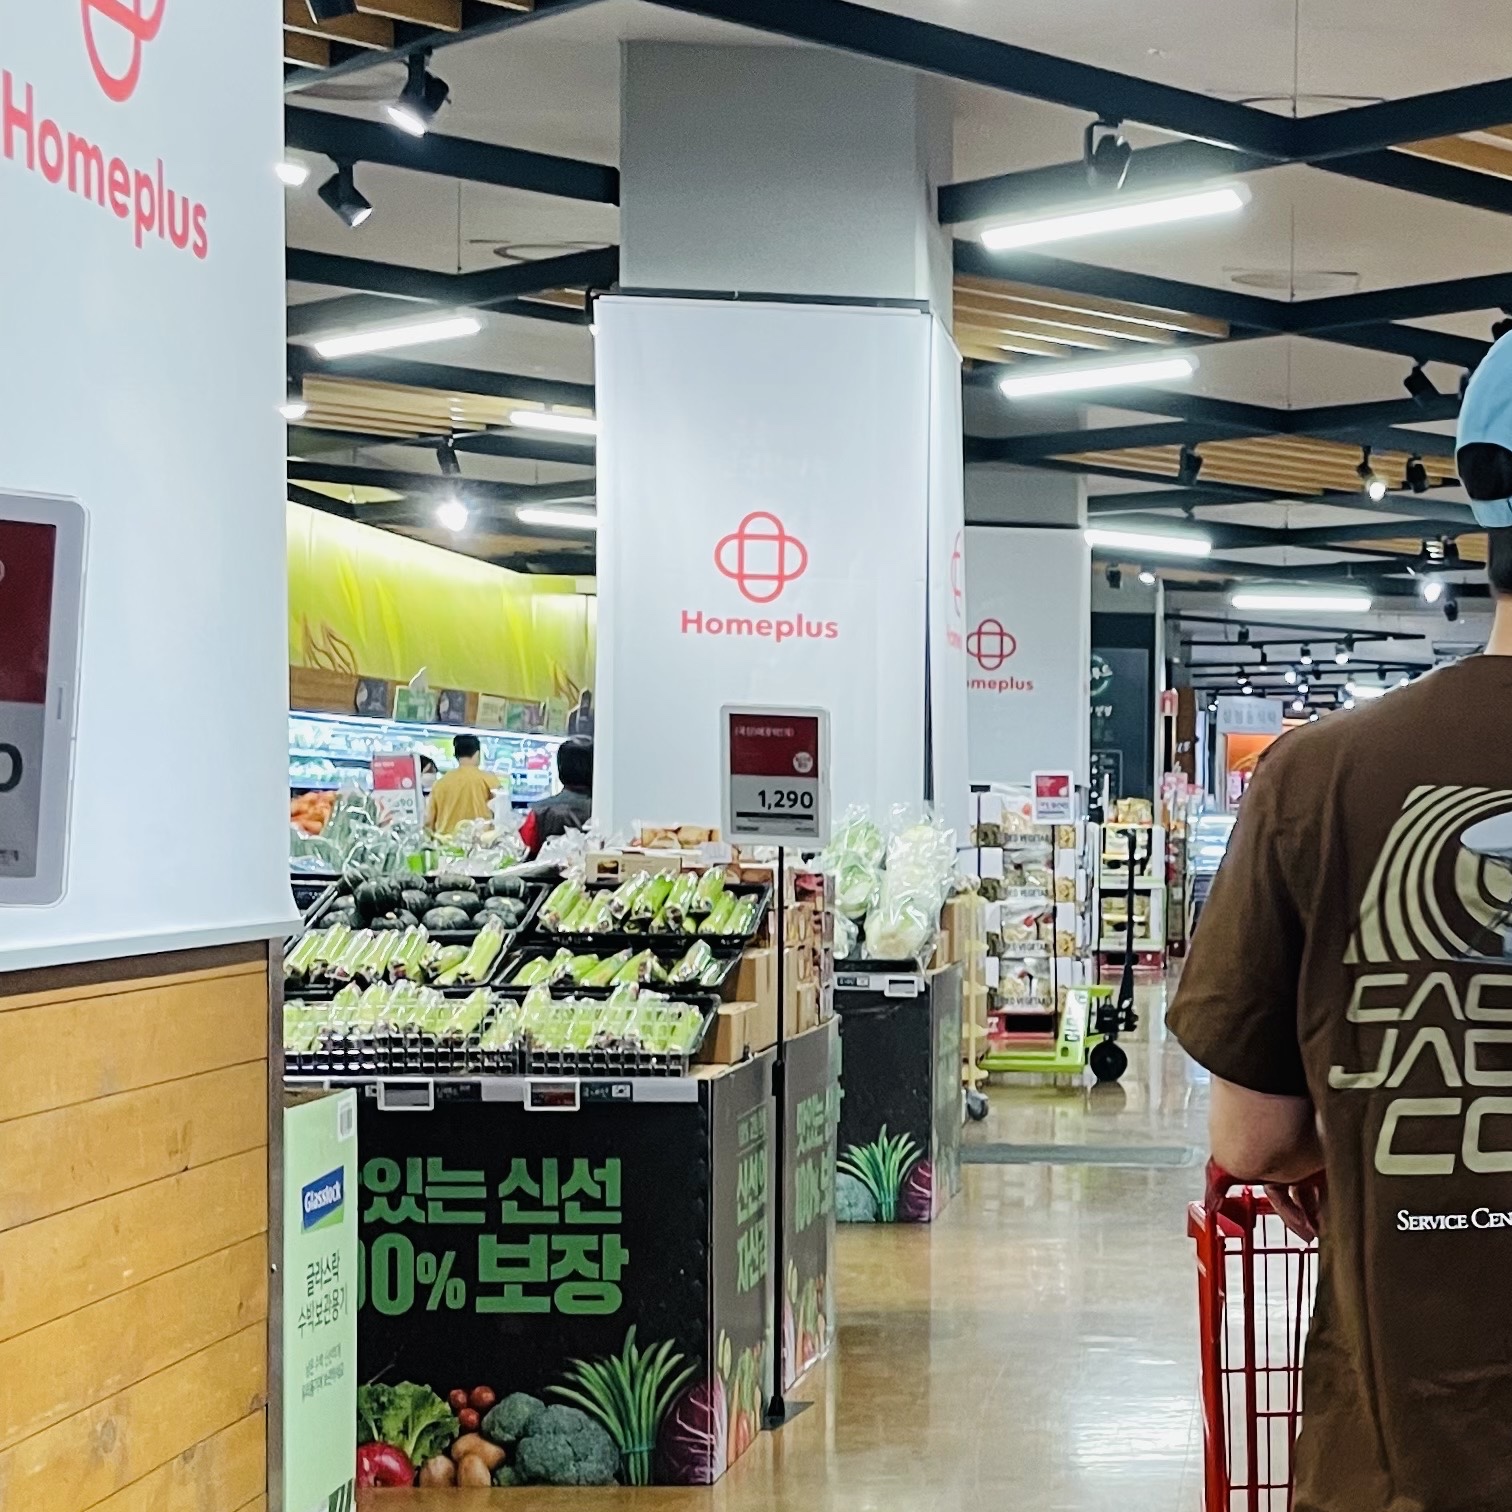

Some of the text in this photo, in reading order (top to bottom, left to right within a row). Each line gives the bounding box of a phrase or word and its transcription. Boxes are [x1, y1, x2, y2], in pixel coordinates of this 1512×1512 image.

[2, 70, 208, 260] Homeplus
[680, 610, 839, 643] Homeplus
[966, 676, 1034, 694] meplus
[758, 789, 814, 811] 1,290
[358, 1156, 623, 1225] 있는 신선
[306, 1248, 341, 1298] 글라스락
[358, 1231, 630, 1317] 0% 보장
[297, 1281, 348, 1339] 수박보관용기
